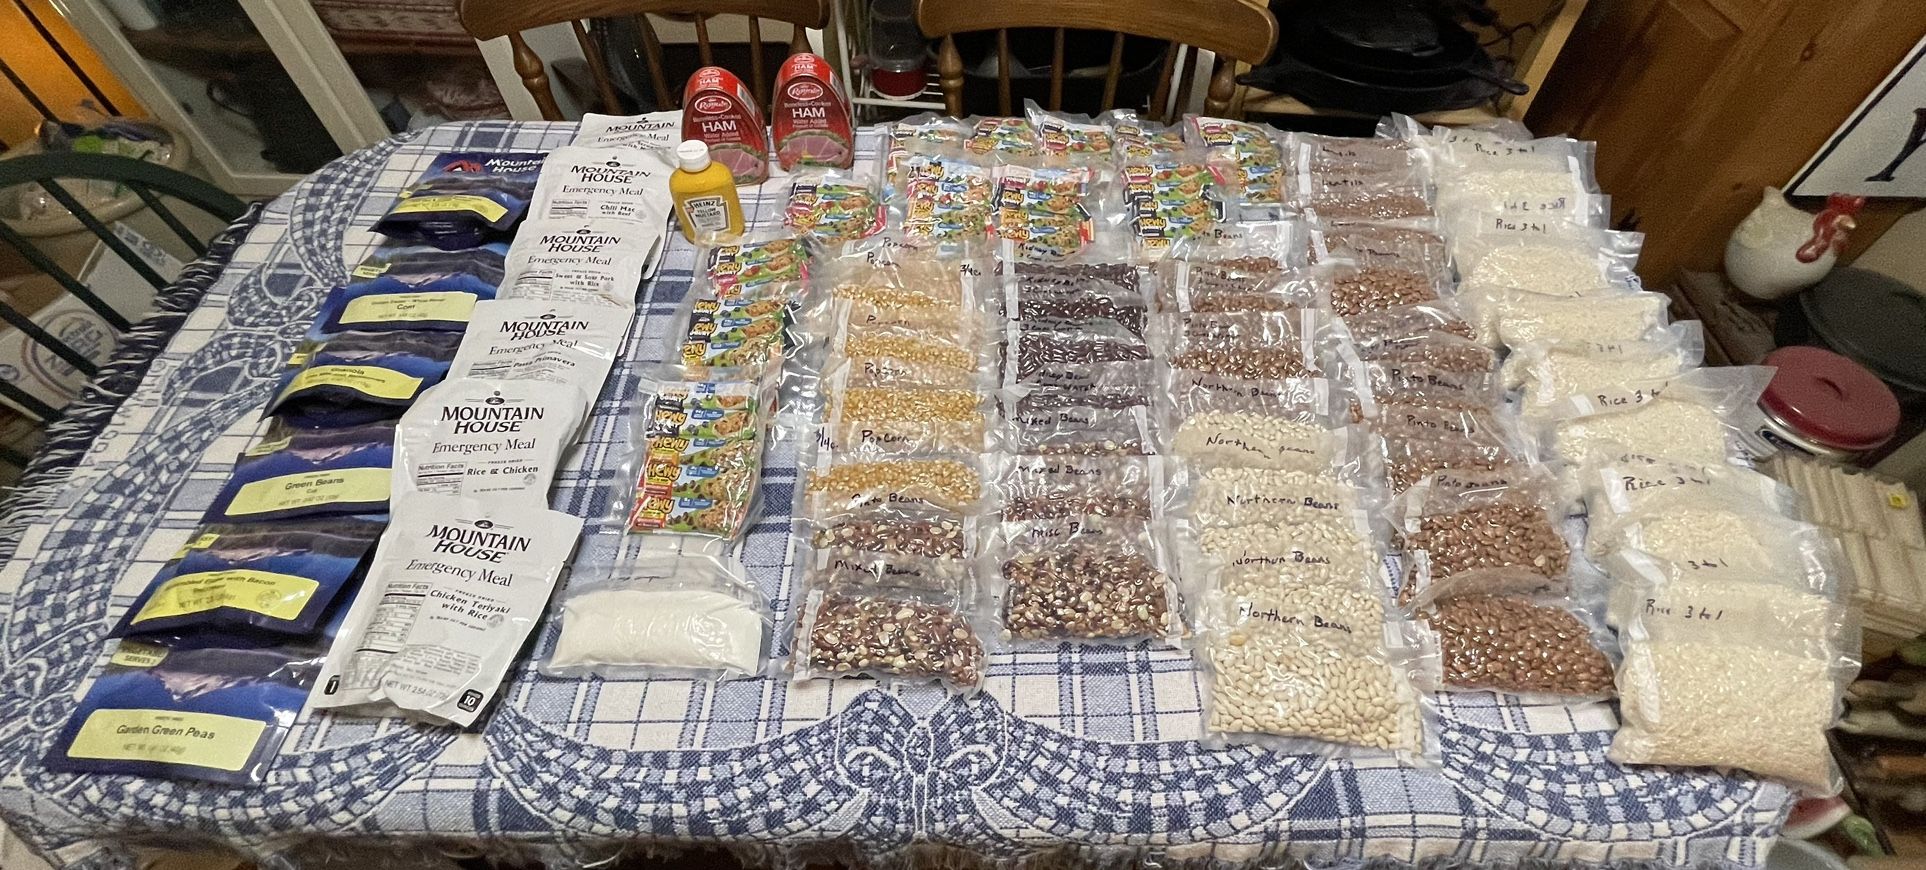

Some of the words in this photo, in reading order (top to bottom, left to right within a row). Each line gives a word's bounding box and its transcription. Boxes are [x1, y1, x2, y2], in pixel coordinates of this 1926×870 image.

[792, 107, 826, 118] HAM
[606, 122, 675, 133] MOUNTAIN
[702, 120, 737, 132] HAM
[647, 133, 670, 141] Meal
[485, 158, 544, 168] Mountai
[492, 165, 537, 173] House
[571, 166, 651, 178] MOUNTAIN
[581, 173, 633, 184] HOUSE
[562, 185, 616, 197] Emergency
[620, 187, 644, 196] Meal
[694, 200, 716, 208] HEINZ
[1521, 223, 1528, 231] 3
[540, 235, 622, 245] MOUNTAIN
[1214, 229, 1243, 239] Beans
[548, 243, 604, 253] HOUSE
[527, 255, 582, 266] Emergency
[585, 256, 612, 266] Meal
[500, 321, 589, 333] MOUNTAIN
[510, 328, 567, 341] HOUSE
[489, 343, 545, 355] Emergency
[1392, 369, 1424, 383] Pinto
[1427, 375, 1465, 391] Beans
[1597, 394, 1628, 407] Rice
[1635, 390, 1643, 403] 3
[441, 406, 545, 421] MOUNTAIN
[1059, 413, 1089, 424] Beans
[453, 420, 523, 434] HOUSE
[1407, 415, 1437, 429] Pinto
[432, 442, 502, 456] Emergency
[505, 438, 536, 450] Meal
[418, 463, 445, 471] Nutrition
[467, 467, 486, 476] Rice
[503, 465, 539, 475] Chicken
[1065, 465, 1102, 476] Beans
[285, 482, 313, 490] Green
[315, 478, 344, 486] Beans
[1437, 475, 1462, 488] Pinto
[1623, 476, 1666, 491] Rice
[889, 492, 924, 504] Beans
[1227, 495, 1296, 506] Northern
[1303, 497, 1340, 510] Beans
[1069, 522, 1104, 535] Beans
[425, 524, 532, 552] MOUNTAIN
[433, 540, 508, 564] HOUSE
[1292, 550, 1331, 565] Beans
[1688, 560, 1700, 570] 3
[406, 559, 477, 581] Emergency
[478, 568, 514, 587] Meal
[247, 576, 277, 586] Bacon
[430, 589, 468, 605] Chicken
[472, 600, 511, 614] Teriyaki
[441, 602, 465, 613] with
[467, 609, 488, 620] Rice
[1685, 605, 1693, 618] 3
[1699, 606, 1711, 620] to
[1715, 610, 1723, 621] 1
[1239, 602, 1305, 626] Northern
[1314, 615, 1352, 633] Beans
[124, 654, 152, 664] SERVES
[384, 680, 397, 688] NET
[400, 682, 412, 691] WT
[463, 695, 476, 706] 10
[117, 724, 149, 735] Garden
[151, 725, 183, 736] Green
[185, 727, 216, 740] Peas
